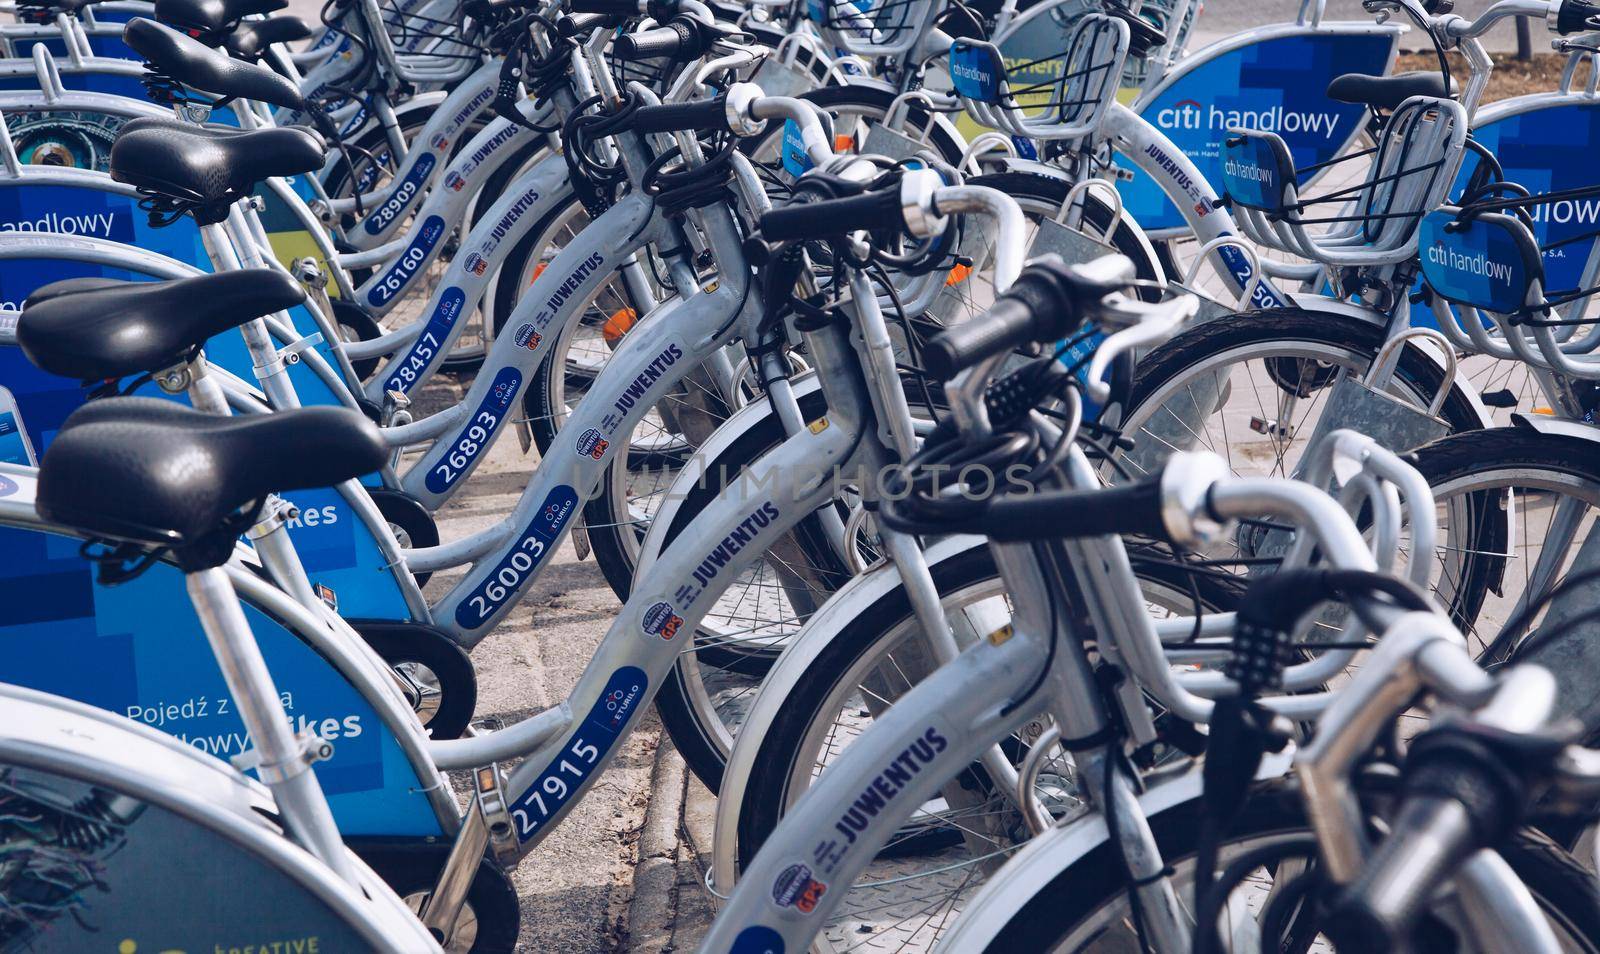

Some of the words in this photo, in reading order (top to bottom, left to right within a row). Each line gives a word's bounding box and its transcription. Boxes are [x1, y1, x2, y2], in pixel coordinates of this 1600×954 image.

[453, 86, 494, 127] JUWENTUS
[1157, 104, 1200, 129] citi
[1208, 104, 1340, 139] handlowy
[471, 123, 519, 167] JUWENTUS
[1144, 143, 1193, 190] JUWENTUS
[1237, 160, 1272, 188] handlowy
[372, 181, 417, 229] 28909
[490, 188, 539, 243] JUWENTUS
[376, 247, 425, 300] 26160
[546, 251, 604, 314] JUWENTUS
[1428, 246, 1447, 266] citi
[1449, 247, 1512, 287] handlowy
[390, 332, 439, 392] 28457
[614, 343, 683, 416] JUWENTUS
[436, 411, 497, 483] 26893
[592, 440, 609, 460] GPS
[692, 501, 780, 588] JUWENTUS
[469, 536, 544, 618] 26003
[661, 614, 684, 640] GPS
[127, 696, 208, 726] Pojedź
[217, 699, 229, 714] z
[512, 738, 599, 835] 27915
[835, 727, 948, 844] JUWENTUS
